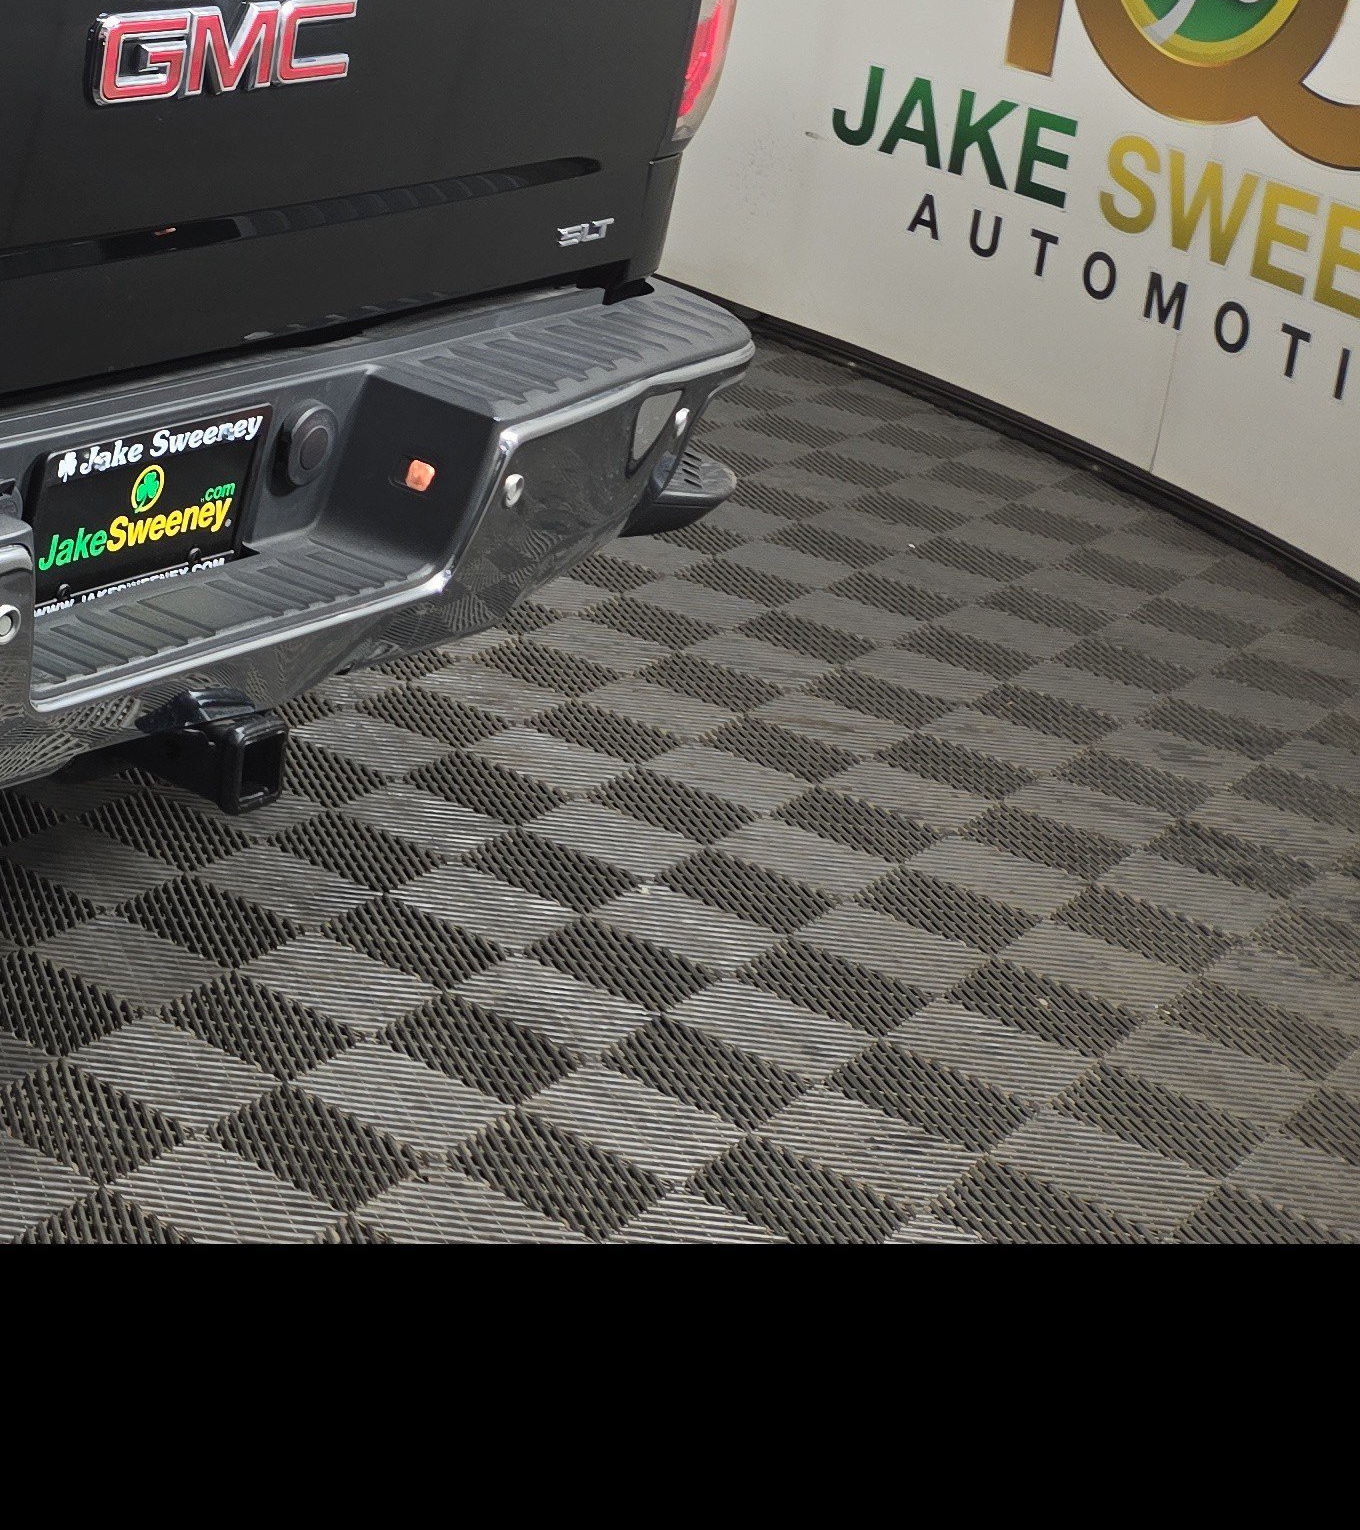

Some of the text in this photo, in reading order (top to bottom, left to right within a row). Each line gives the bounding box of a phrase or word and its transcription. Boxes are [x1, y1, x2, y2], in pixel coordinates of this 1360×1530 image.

[557, 217, 615, 247] SLT
[832, 65, 1360, 320] JAKE SWEE
[907, 193, 1352, 401] AUTOMOTI
[80, 415, 263, 475] Jake Sweeney
